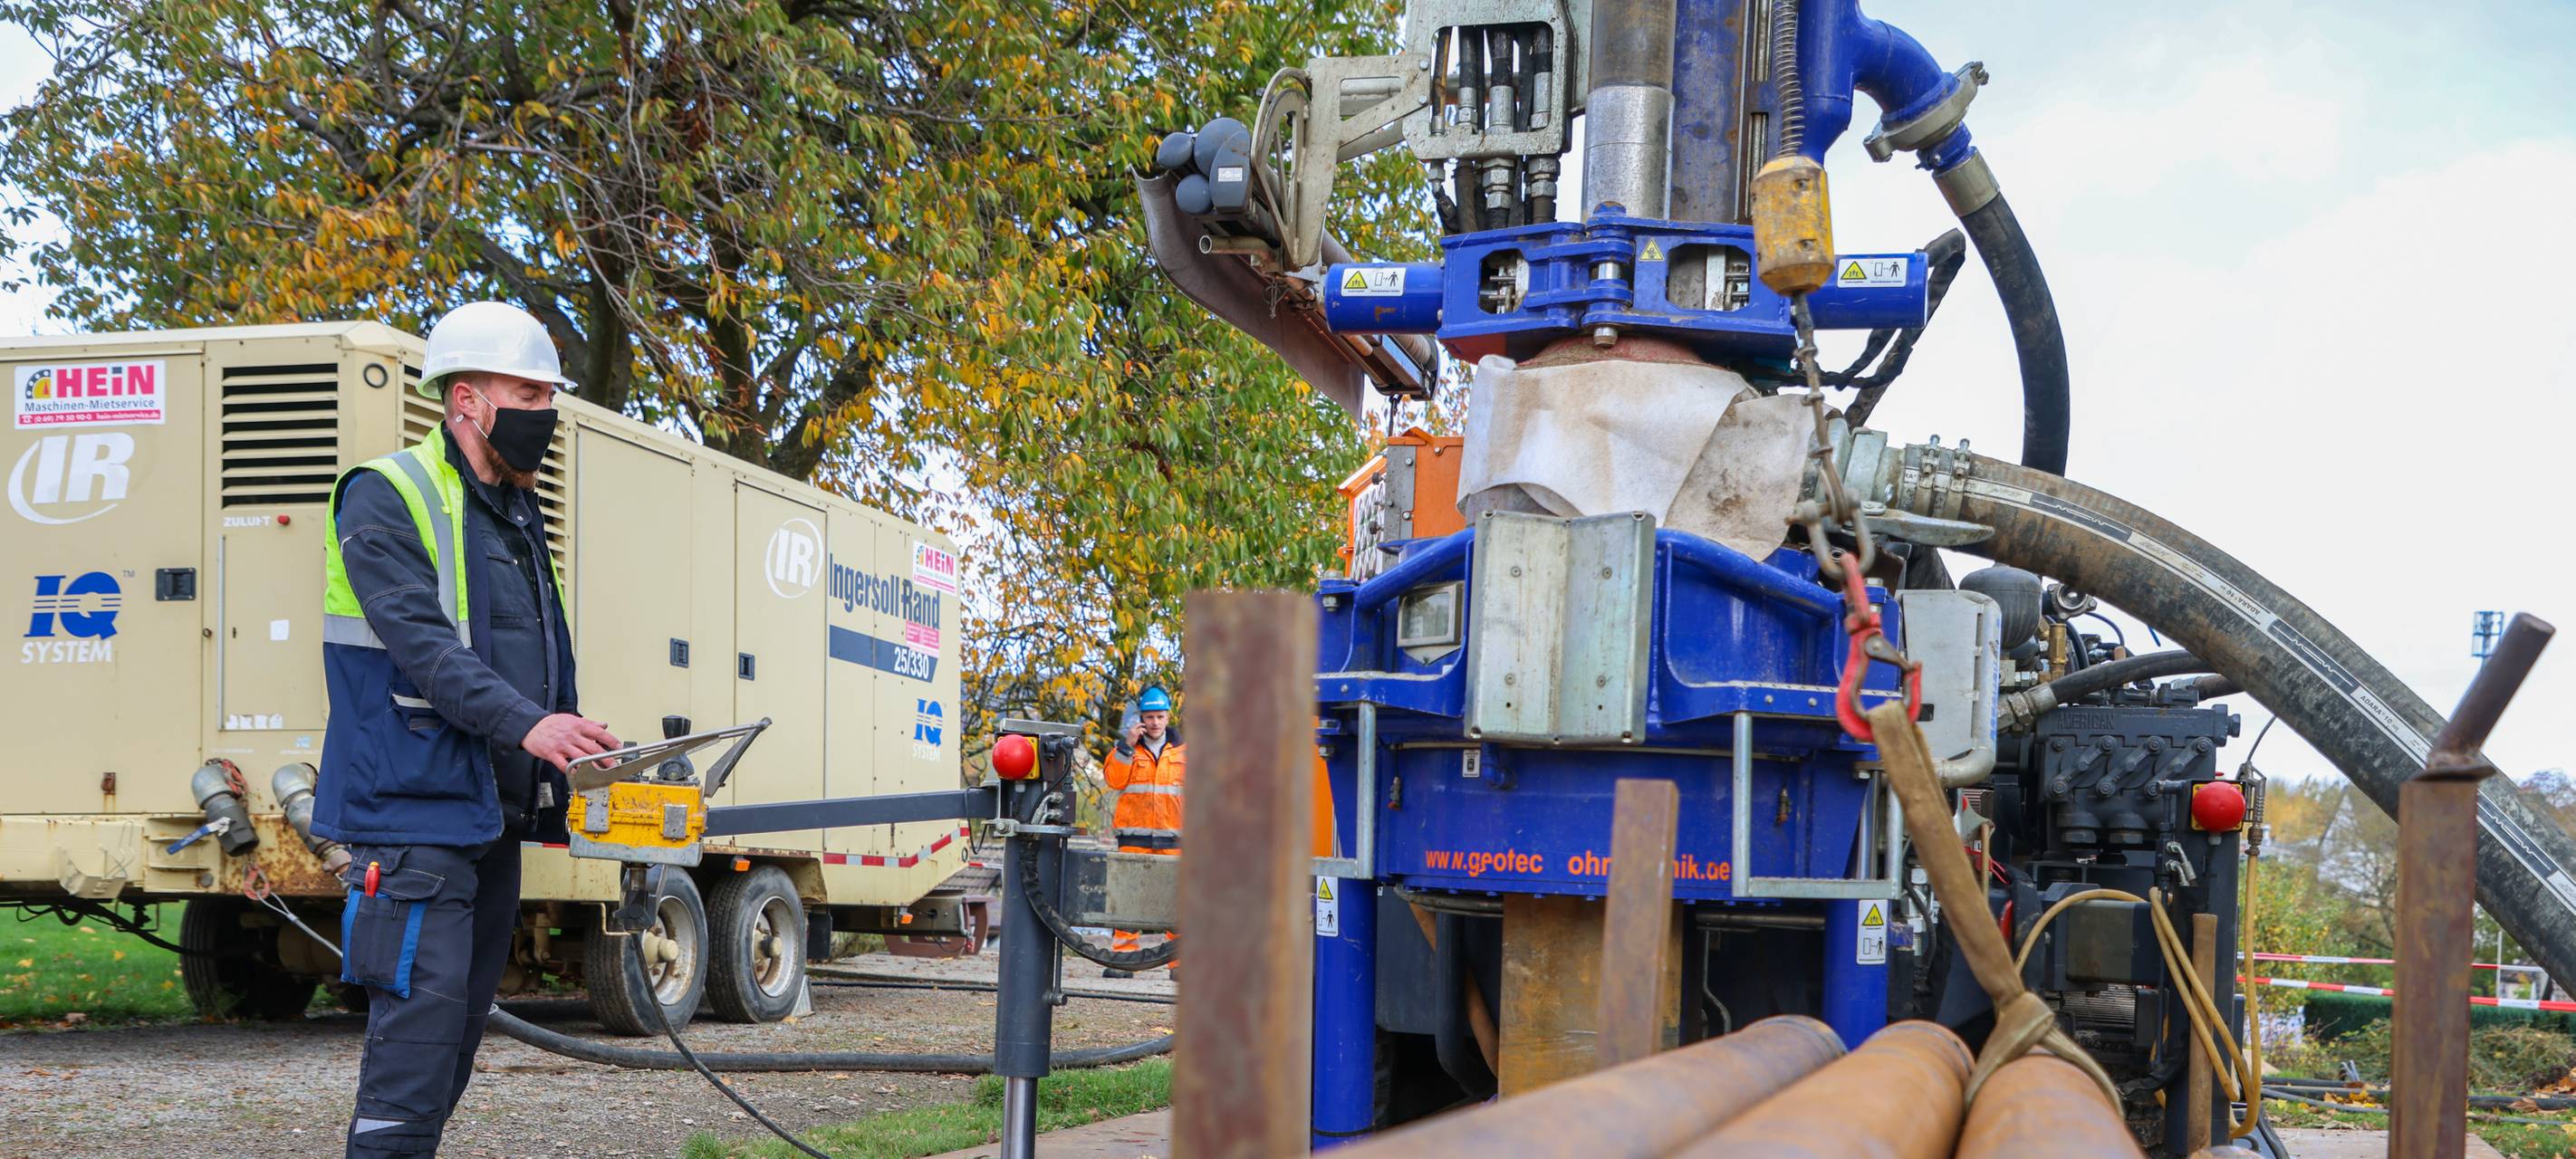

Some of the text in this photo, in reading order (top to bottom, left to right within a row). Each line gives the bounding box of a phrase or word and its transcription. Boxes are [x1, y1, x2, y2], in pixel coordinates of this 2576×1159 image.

[24, 398, 155, 413] Maschinen-Mietservice
[33, 432, 135, 504] IR
[224, 516, 271, 527] ZULUFT
[774, 528, 814, 588] IR
[24, 571, 122, 640] IQ
[830, 552, 939, 629] Ingersoll Rand
[22, 640, 113, 664] SYSTEM
[894, 647, 929, 679] 25/330
[914, 698, 943, 747] IQ
[912, 744, 940, 761] SYSTEM
